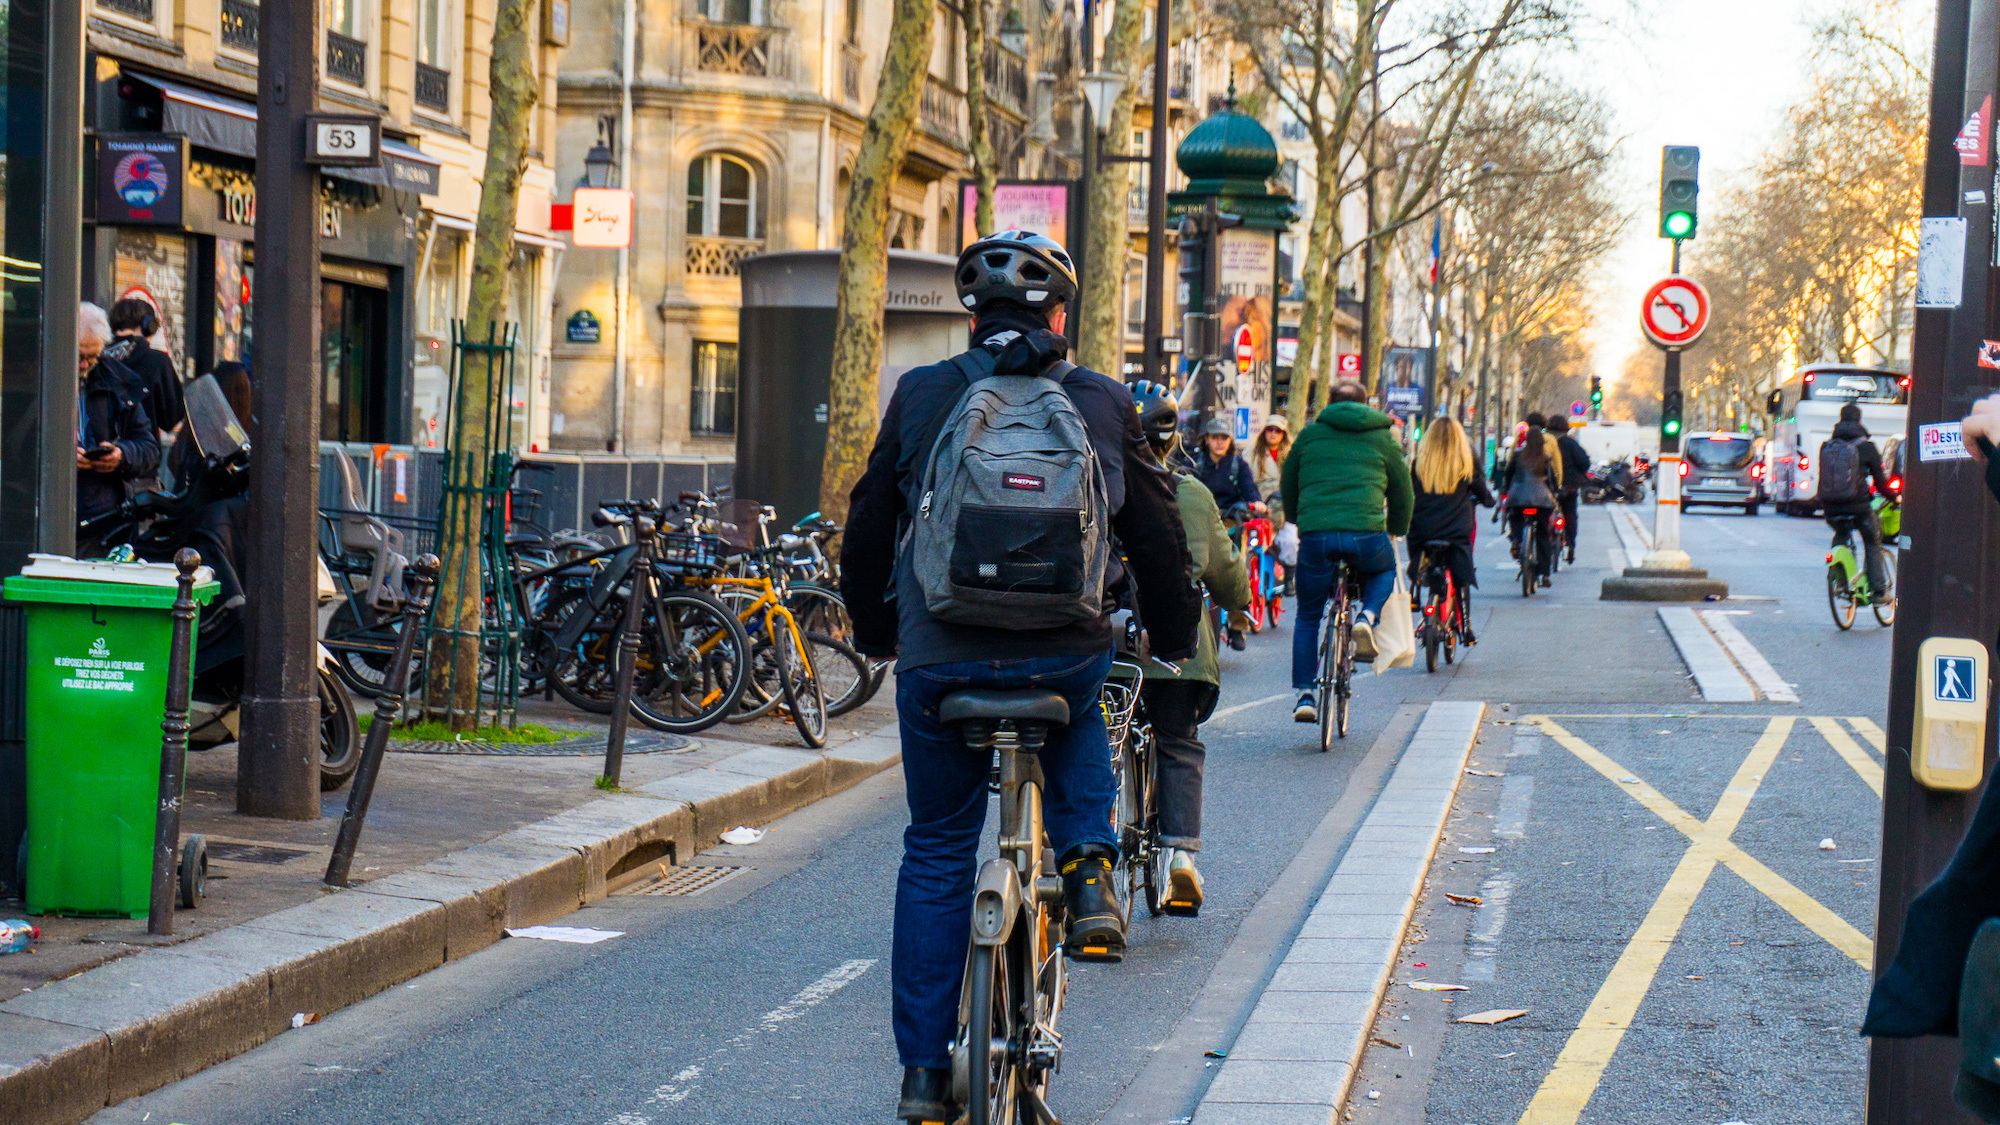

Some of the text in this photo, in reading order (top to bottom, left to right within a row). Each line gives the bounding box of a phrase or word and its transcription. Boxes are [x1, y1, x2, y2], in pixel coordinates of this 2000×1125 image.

[329, 129, 356, 149] 53
[1954, 137, 1979, 150] ES
[320, 203, 341, 239] EN
[1008, 477, 1040, 486] EASTPAK
[88, 648, 110, 656] PARIS
